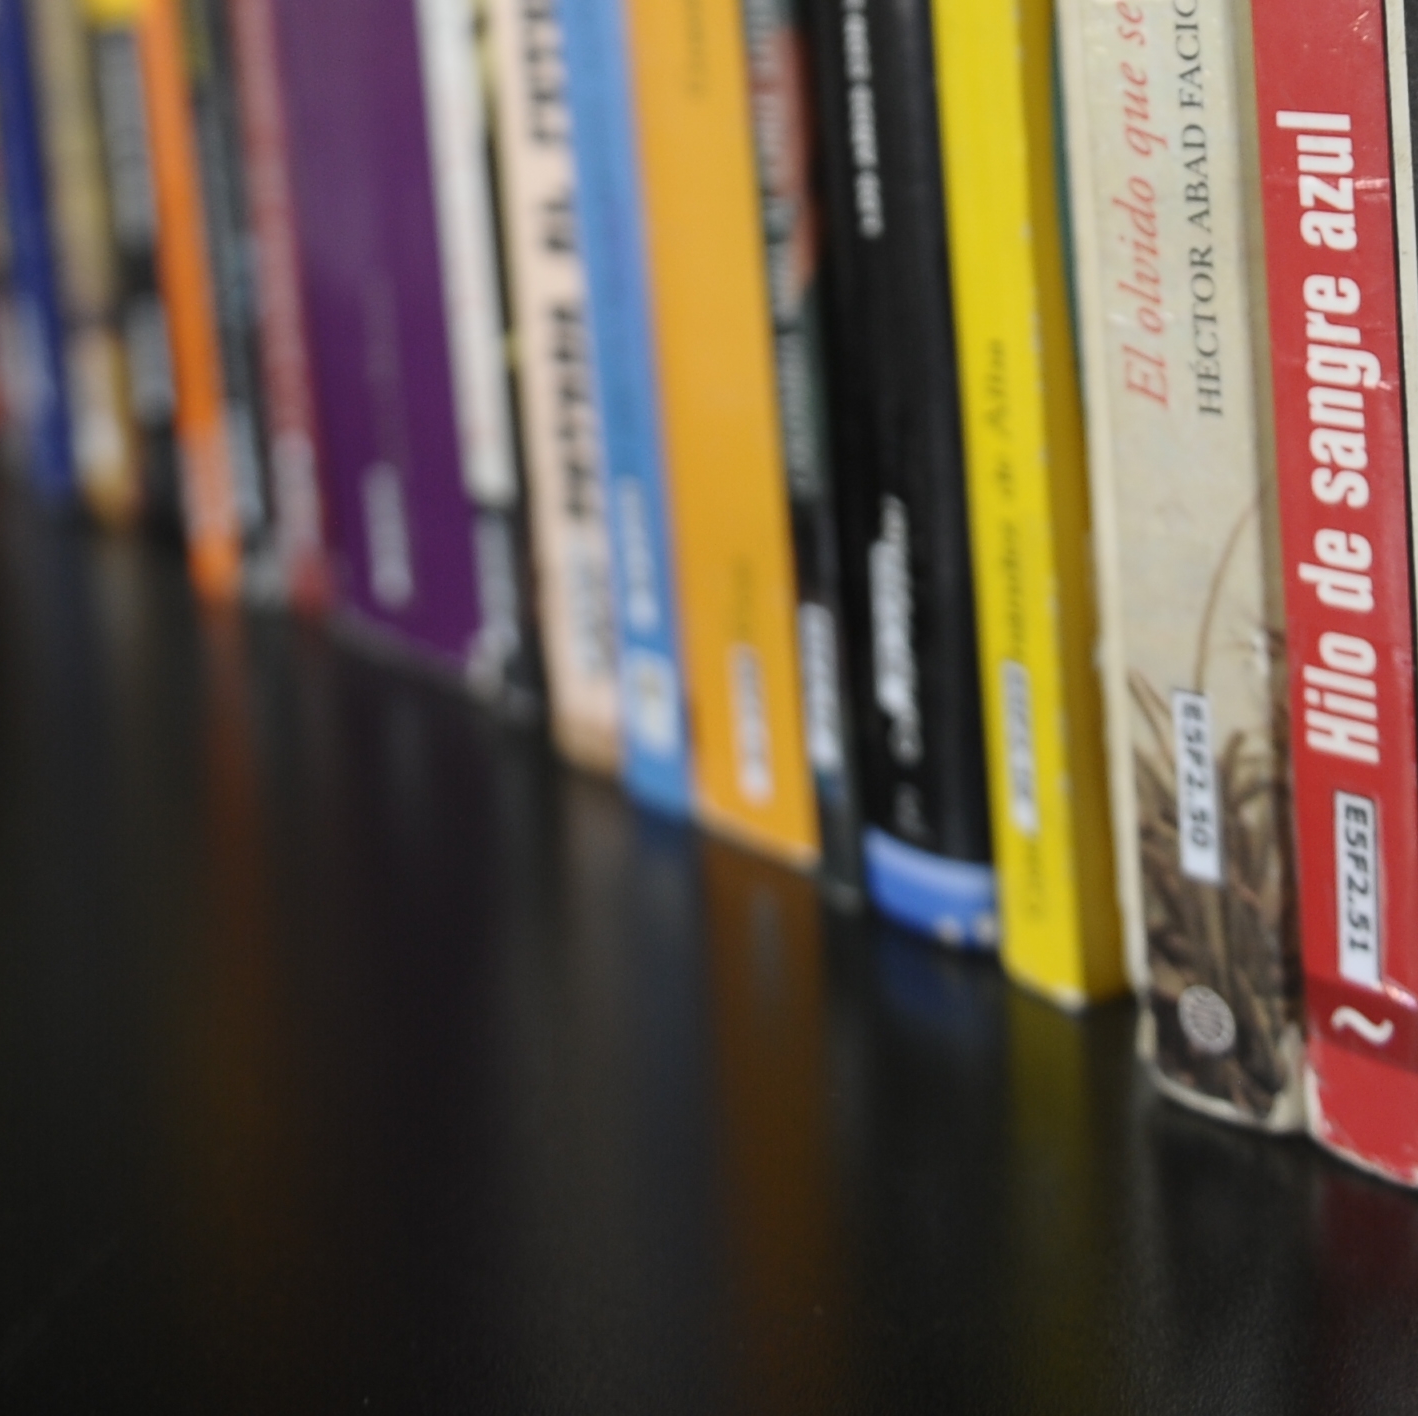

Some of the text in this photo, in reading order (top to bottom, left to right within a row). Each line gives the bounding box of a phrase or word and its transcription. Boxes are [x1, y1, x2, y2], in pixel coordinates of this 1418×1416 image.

[1121, 62, 1167, 158] que
[1180, 120, 1211, 232] ABAD
[1112, 171, 1167, 335] olvido
[1123, 341, 1169, 410] El
[1180, 245, 1224, 419] HÉCTOR
[1276, 110, 1382, 765] Hilo de sangre azul
[1344, 800, 1371, 954] E5F2.51
